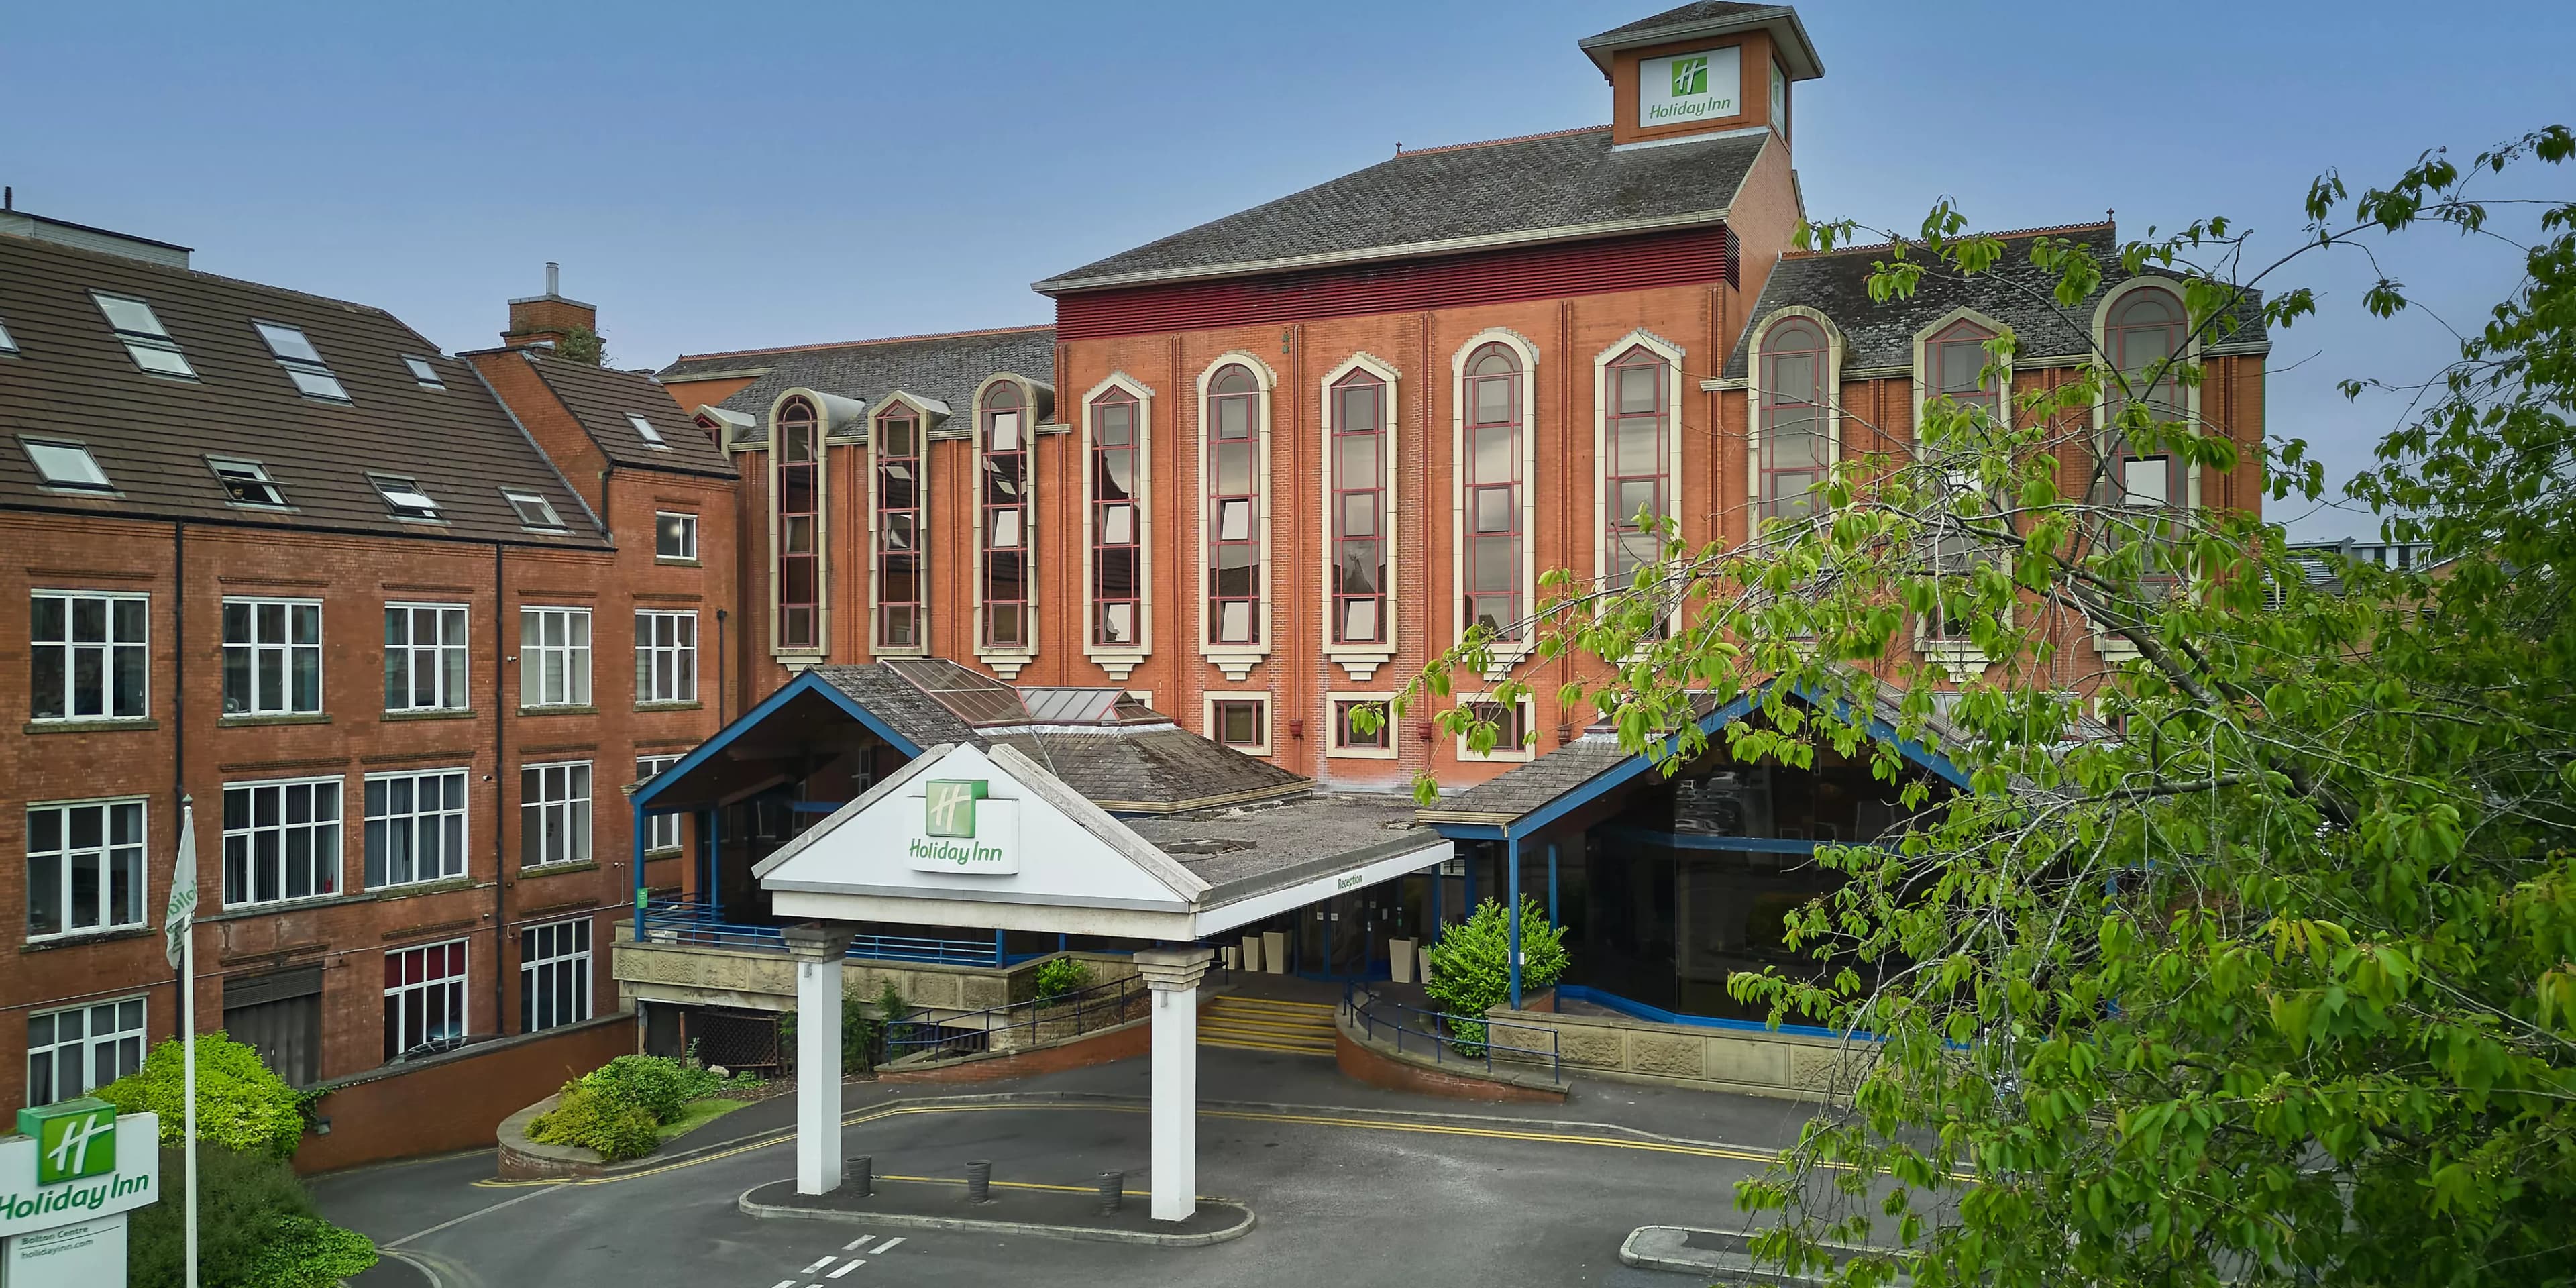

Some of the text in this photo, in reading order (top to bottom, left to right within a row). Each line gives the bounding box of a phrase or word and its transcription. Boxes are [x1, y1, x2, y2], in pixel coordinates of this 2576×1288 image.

[1650, 96, 1731, 119] Holiday Inn
[909, 838, 1002, 865] Holiday Inn
[1338, 874, 1363, 890] Reception
[0, 1173, 150, 1220] Holiday Inn
[21, 1227, 89, 1246] Bolton Centre
[21, 1239, 94, 1259] holidayinn.com
